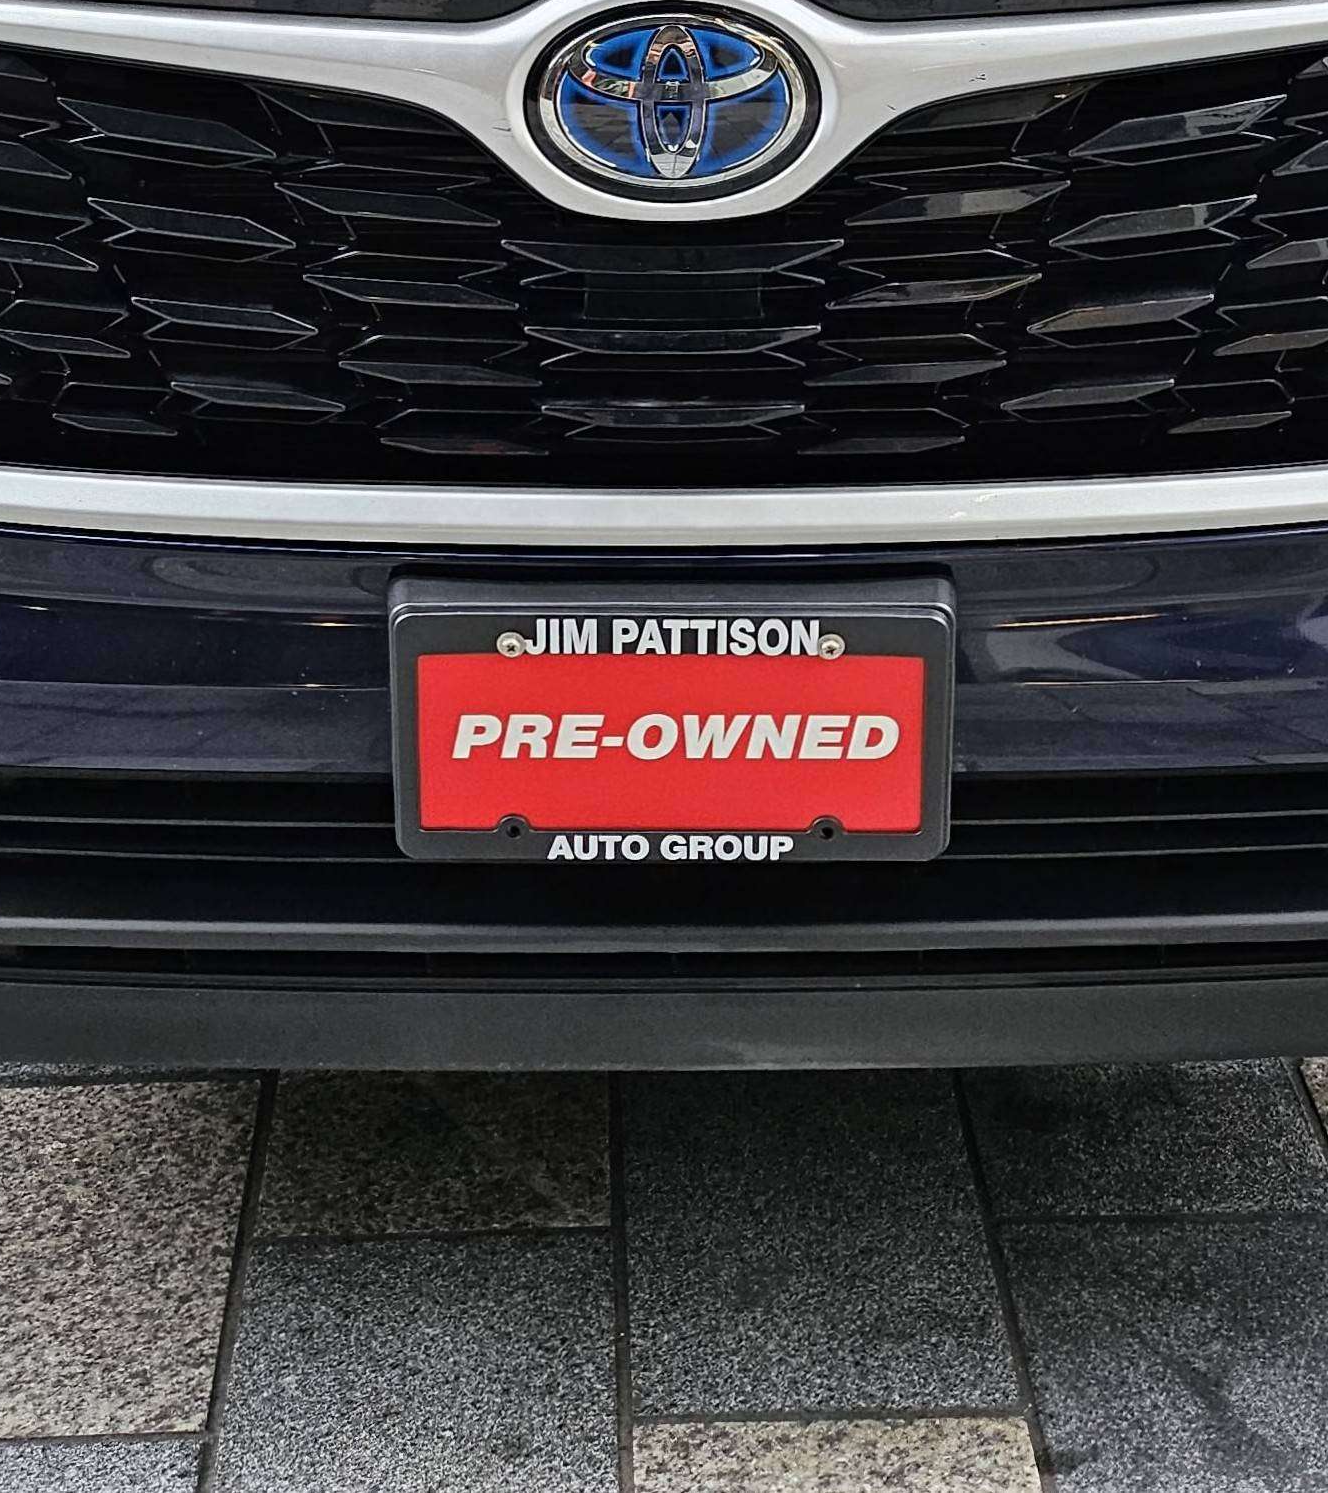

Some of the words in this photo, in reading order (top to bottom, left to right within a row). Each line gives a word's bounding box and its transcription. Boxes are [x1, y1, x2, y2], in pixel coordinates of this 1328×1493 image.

[524, 618, 592, 656] JIM
[612, 618, 820, 656] PATTISON
[451, 713, 900, 760] PRE-OWNED
[546, 834, 651, 861] AUTO
[659, 833, 794, 862] GROUP
